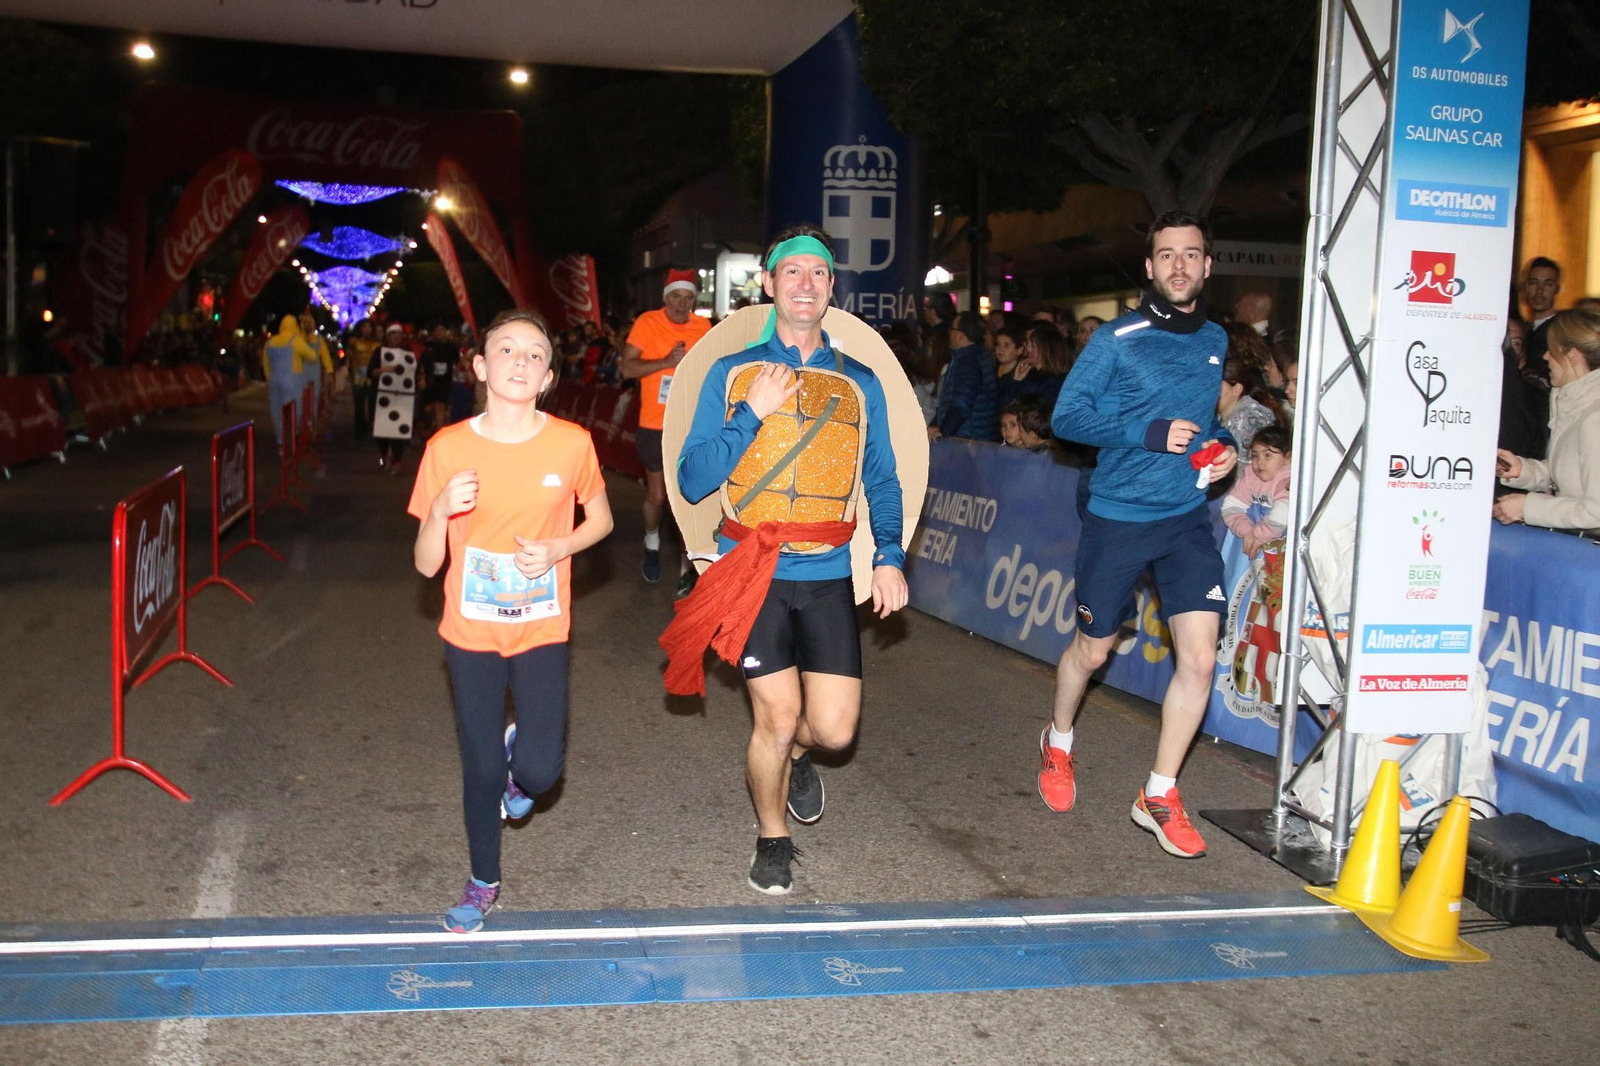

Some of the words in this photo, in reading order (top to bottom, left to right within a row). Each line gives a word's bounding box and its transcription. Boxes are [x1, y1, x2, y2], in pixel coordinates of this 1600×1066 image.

[1412, 66, 1427, 79] DS
[1431, 68, 1508, 87] AUTOMOBILES
[1431, 105, 1483, 124] GRUPO
[1405, 125, 1469, 145] SALINAS
[1472, 131, 1503, 148] CAR
[1409, 188, 1497, 212] DECATHLON
[1408, 569, 1441, 580] BUEN
[1366, 628, 1439, 649] Almericar
[1359, 678, 1376, 690] La
[1377, 678, 1401, 690] Voz
[1401, 677, 1418, 690] de
[1418, 676, 1467, 690] Almería
